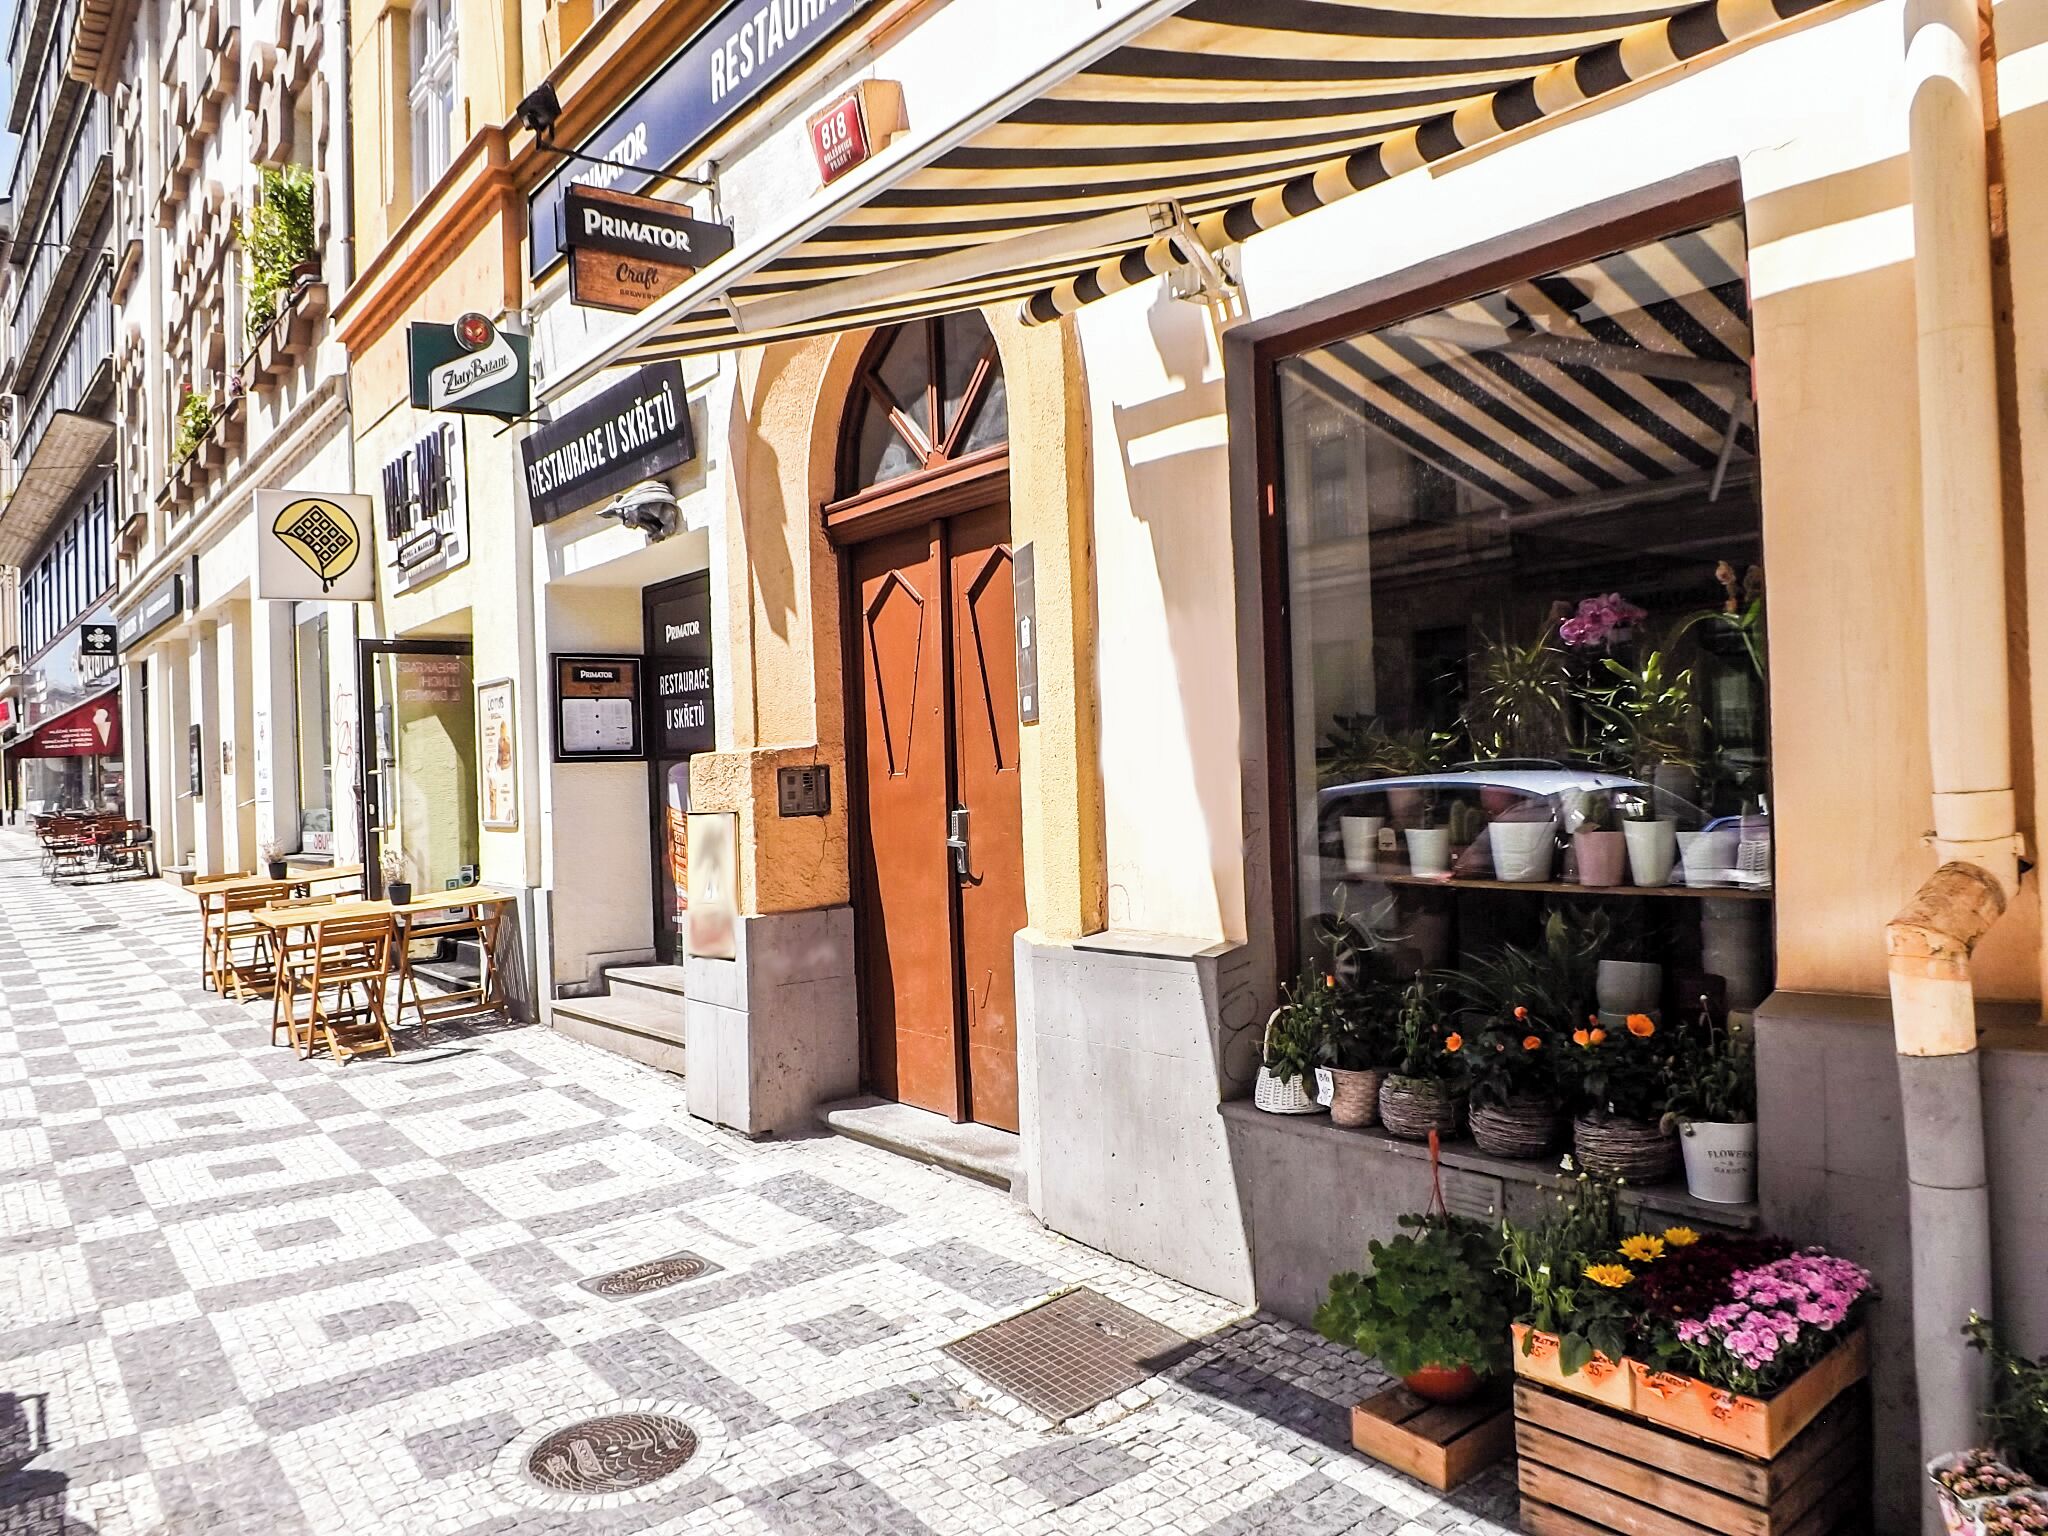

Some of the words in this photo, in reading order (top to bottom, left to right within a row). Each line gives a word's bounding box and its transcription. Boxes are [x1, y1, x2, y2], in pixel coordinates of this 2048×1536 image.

[711, 0, 837, 104] RESTAUR
[821, 111, 847, 150] 818
[583, 208, 692, 252] PRIMATOR
[616, 262, 659, 290] Craft
[528, 428, 606, 498] RESTAURACE
[605, 420, 618, 459] U
[618, 380, 677, 453] SKŘETŮ
[665, 620, 700, 643] PRIMATOR
[580, 670, 613, 679] PRIMATOR
[659, 667, 710, 696] RESTAURACE
[666, 709, 672, 730] U
[673, 700, 705, 729] SKŘETŮ
